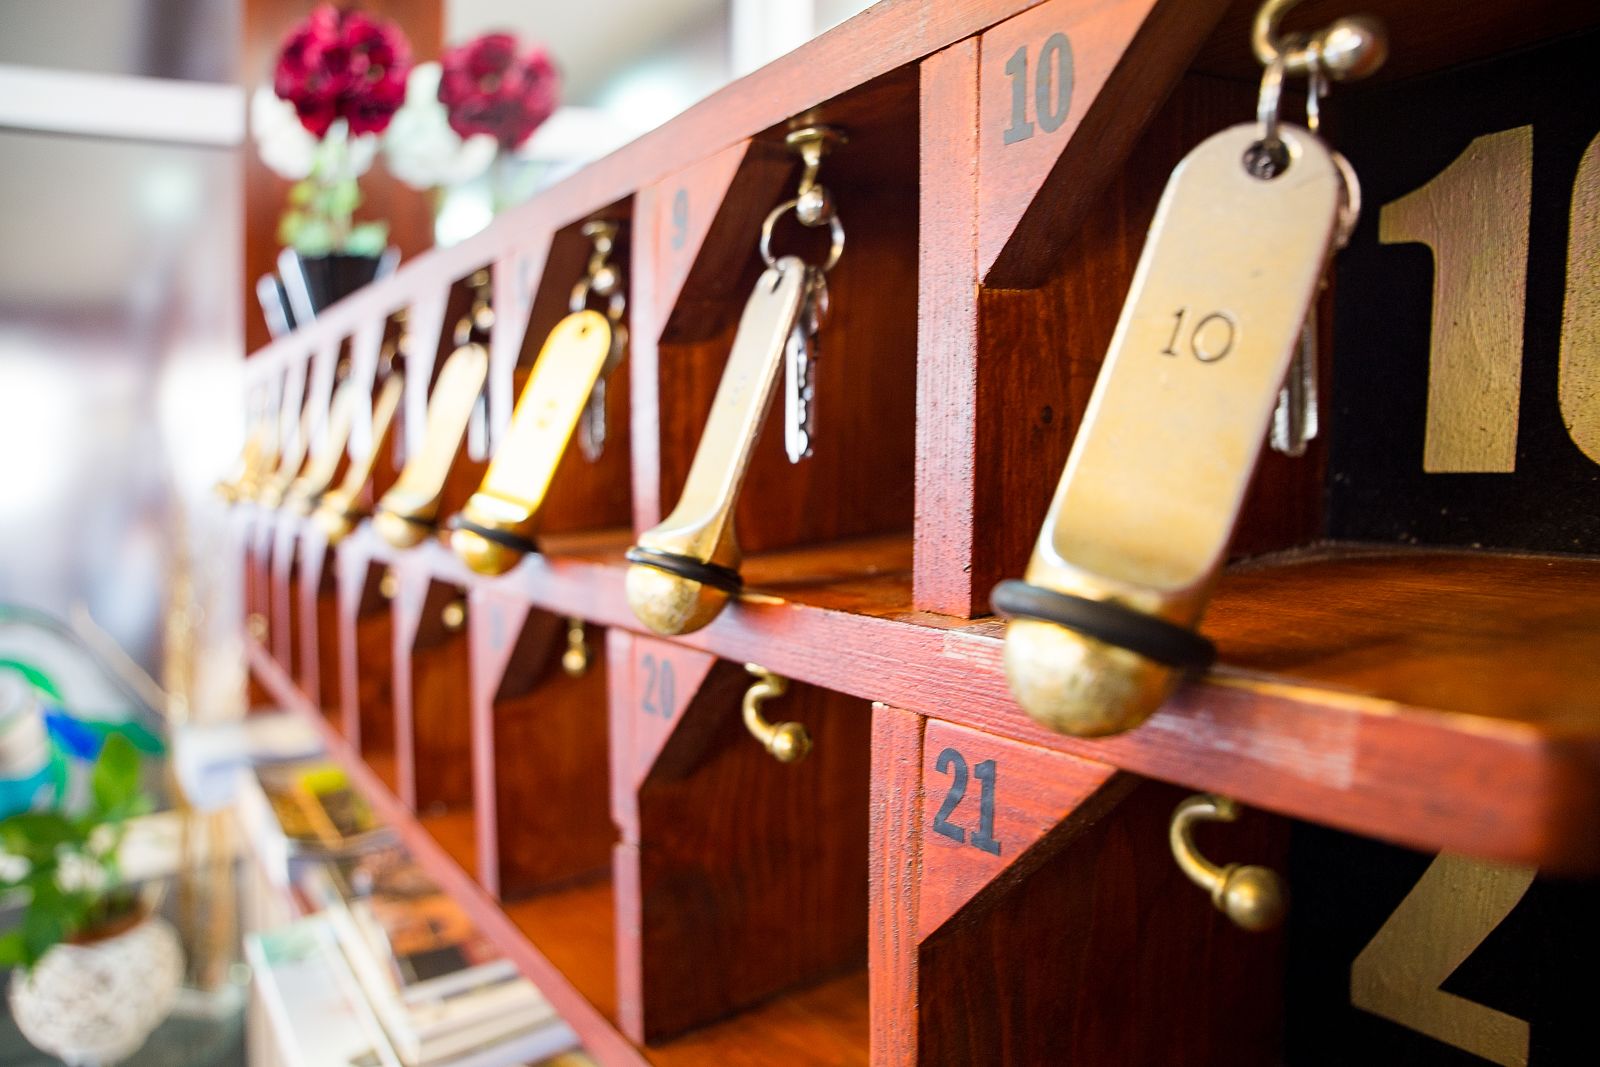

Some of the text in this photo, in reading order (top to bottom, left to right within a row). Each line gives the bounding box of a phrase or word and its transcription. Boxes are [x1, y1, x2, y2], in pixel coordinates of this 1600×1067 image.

[1003, 32, 1074, 146] 10
[1160, 307, 1235, 364] 10
[641, 653, 675, 720] 20
[933, 747, 1001, 856] 21
